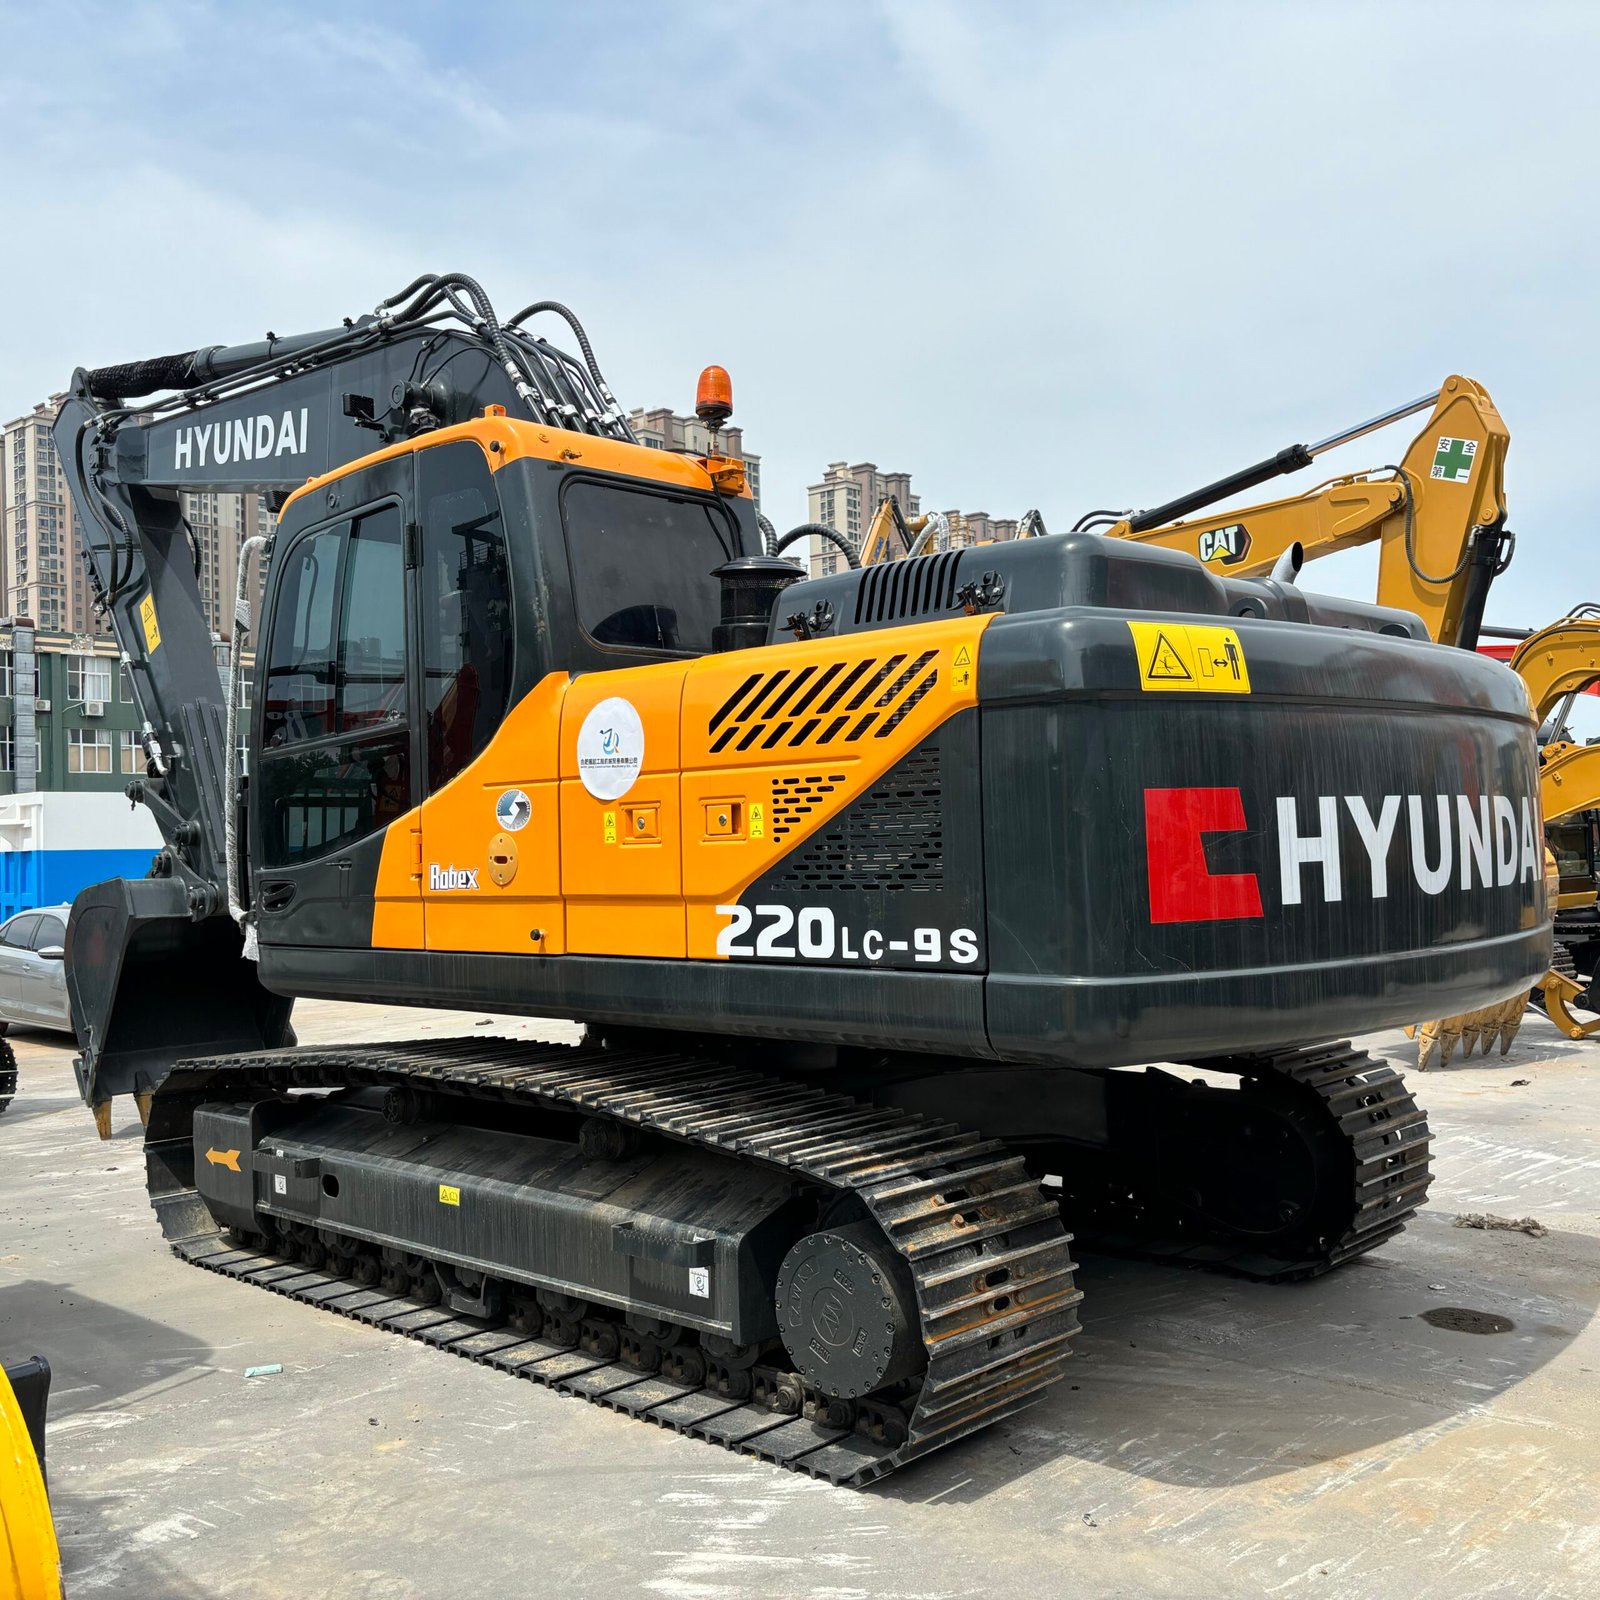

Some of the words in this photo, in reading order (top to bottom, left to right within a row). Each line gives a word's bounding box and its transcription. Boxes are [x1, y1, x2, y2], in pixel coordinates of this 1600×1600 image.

[175, 408, 308, 470] HYUNDAI
[1200, 526, 1238, 561] CAT
[1276, 795, 1541, 905] HYUNDAI
[430, 863, 479, 890] Robex
